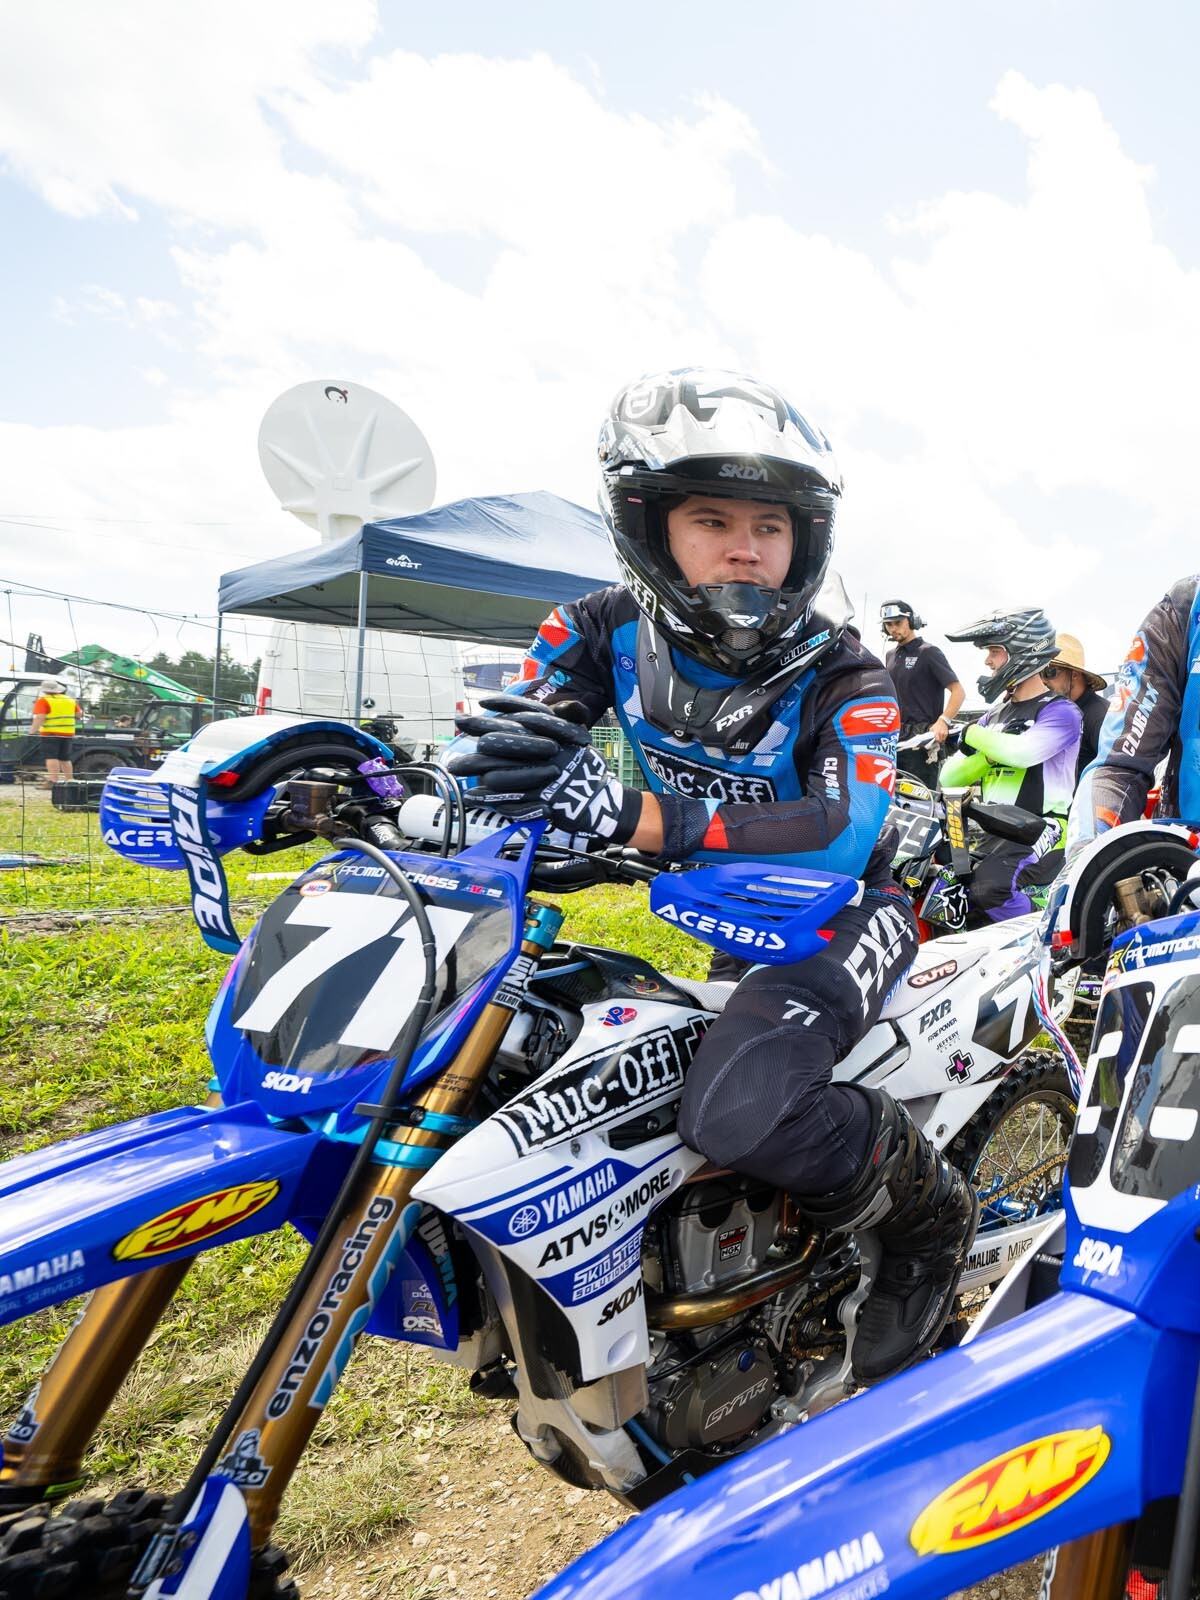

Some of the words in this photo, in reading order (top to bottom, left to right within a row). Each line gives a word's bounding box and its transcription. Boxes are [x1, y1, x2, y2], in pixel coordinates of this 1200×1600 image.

[718, 463, 769, 482] SKDA
[386, 557, 422, 570] QUEST
[780, 630, 830, 665] CLUBMX
[716, 704, 753, 733] FXR
[1121, 682, 1160, 758] CLUBMX
[552, 747, 607, 820] FXR
[170, 792, 231, 937] RIDE
[338, 865, 460, 891] PROMOCROSS
[655, 903, 787, 950] ACERBIS
[234, 891, 473, 1052] 71
[782, 999, 821, 1027] 71
[918, 998, 952, 1035] FXR
[261, 1071, 313, 1094] SKDA
[524, 1037, 677, 1141] Muc-Off
[537, 1167, 670, 1268] ATVS&MORE
[541, 1163, 617, 1224] YAMAHA
[111, 1179, 280, 1262] FMF
[0, 1249, 86, 1297] AMAHA
[573, 1250, 641, 1301] SOLUTIONS.CO
[963, 1246, 1002, 1272] AMALUBE
[266, 1196, 396, 1422] enzoracing
[704, 1377, 769, 1430] GYTR
[912, 1425, 1105, 1557] FMF
